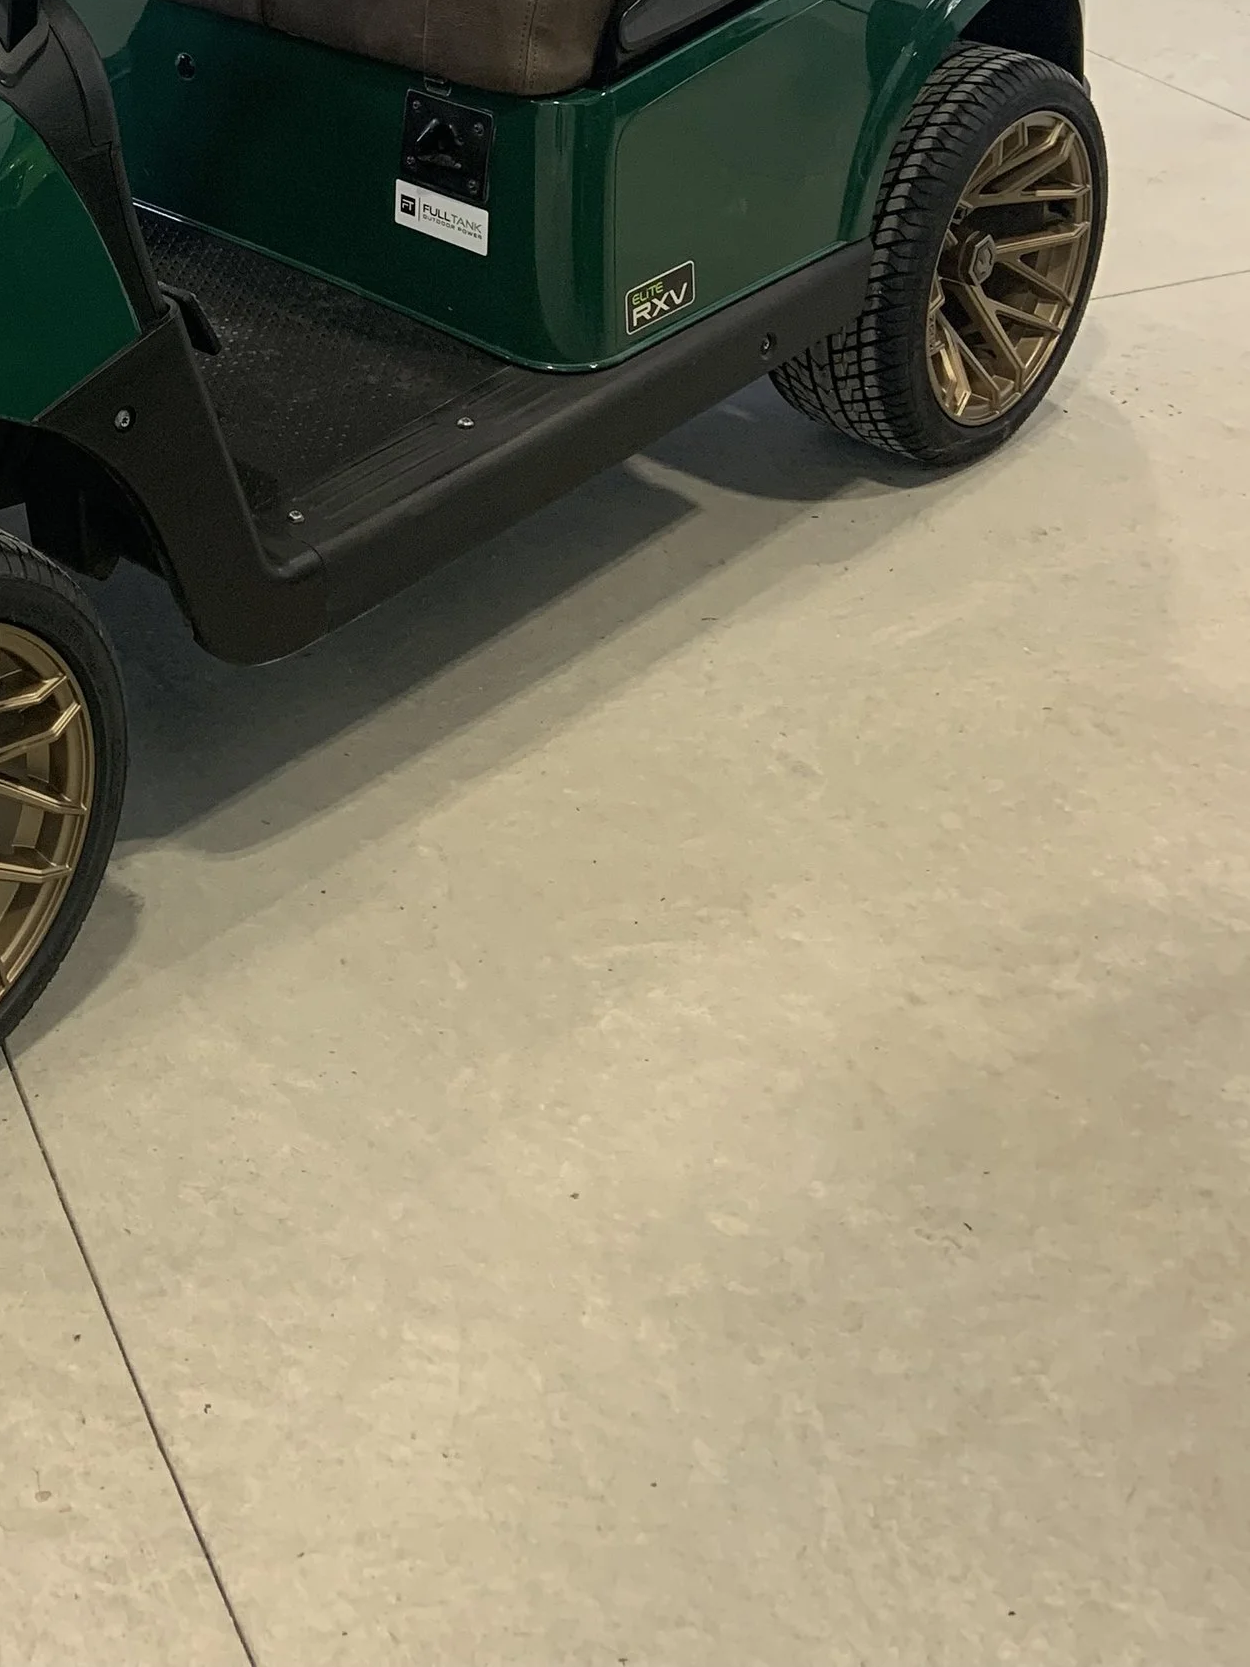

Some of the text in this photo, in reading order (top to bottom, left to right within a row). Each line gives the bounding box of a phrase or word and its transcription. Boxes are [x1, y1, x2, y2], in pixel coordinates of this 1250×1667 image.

[422, 214, 483, 240] OUTDOOR POWER
[632, 281, 664, 306] ELITE
[632, 281, 688, 327] RXV
